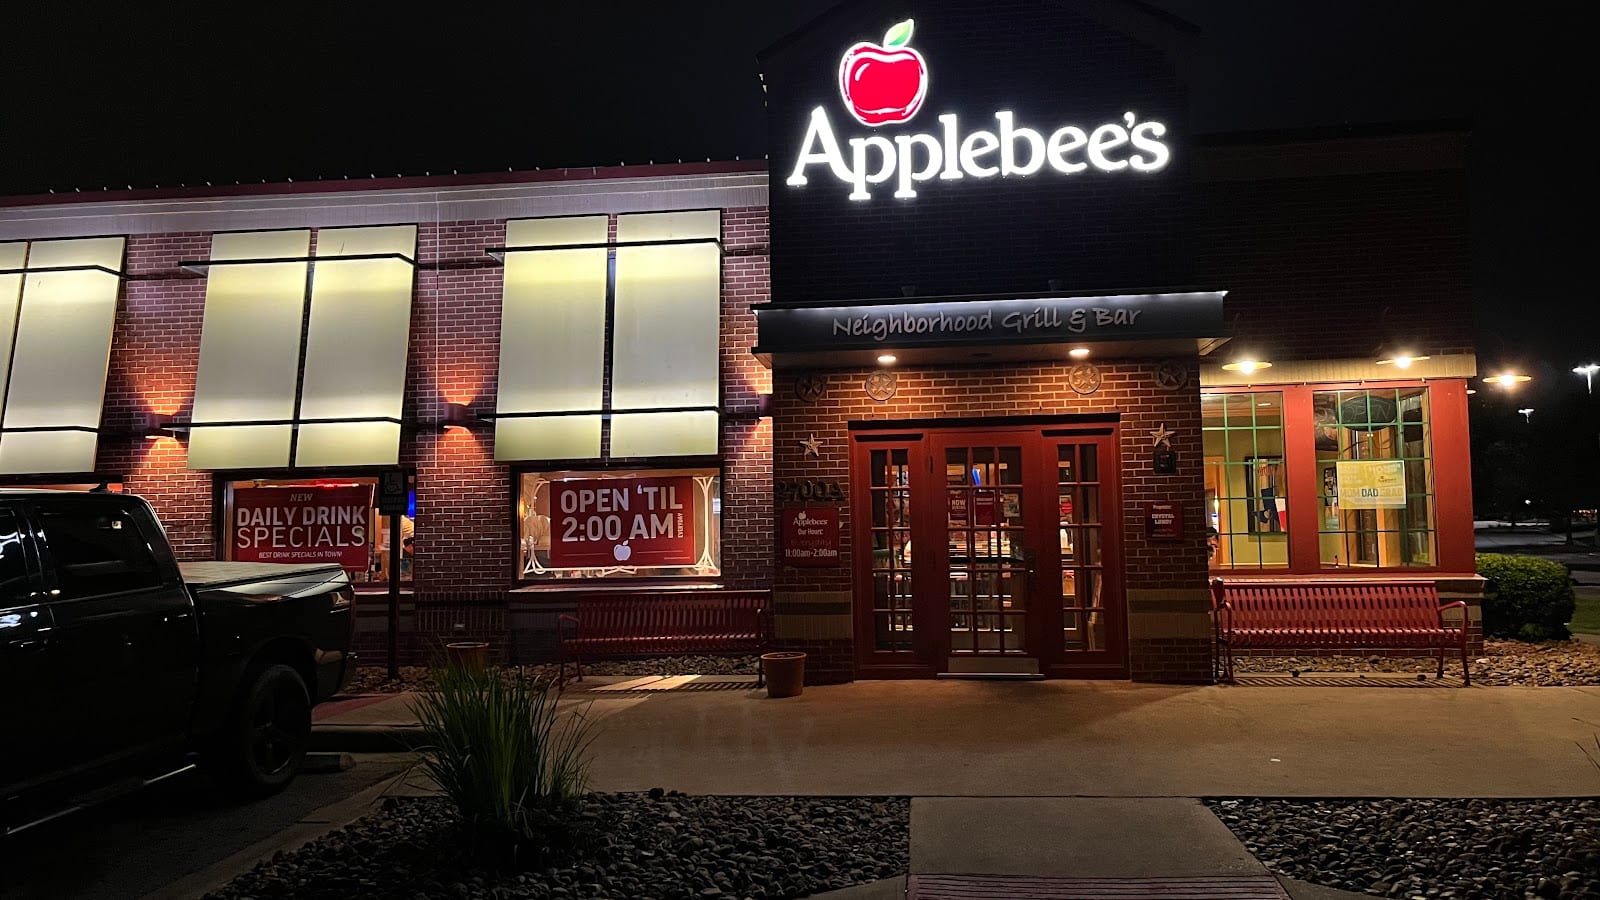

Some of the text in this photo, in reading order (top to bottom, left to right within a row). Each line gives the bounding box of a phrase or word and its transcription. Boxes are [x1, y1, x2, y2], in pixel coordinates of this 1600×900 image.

[787, 106, 1169, 200] Applebee's
[833, 306, 1142, 341] Neighborhood Grill & Bar
[290, 493, 313, 502] NEW
[560, 484, 683, 513] OPEN 'TIL
[1361, 488, 1379, 497] DAD
[237, 505, 366, 526] DAILY DRINK
[562, 513, 674, 542] 2:00 AM
[237, 525, 366, 549] SPECIALS
[258, 551, 272, 559] BEST
